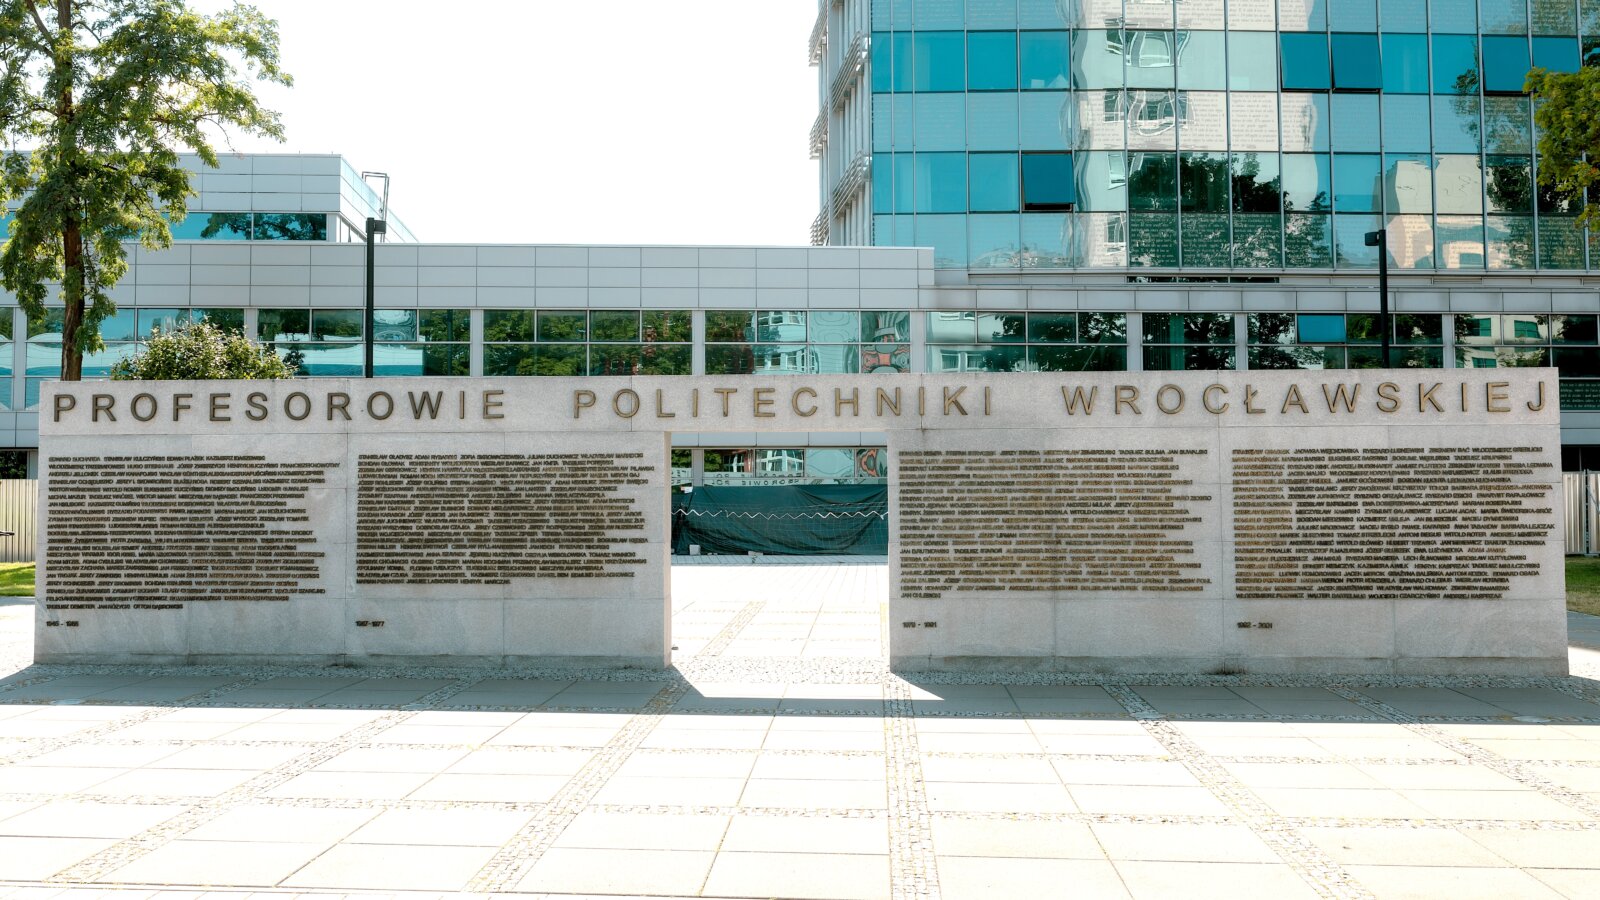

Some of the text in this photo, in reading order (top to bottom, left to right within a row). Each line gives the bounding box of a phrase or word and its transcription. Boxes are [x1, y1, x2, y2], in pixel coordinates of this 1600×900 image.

[54, 389, 505, 422] PROFESOROWIE
[573, 386, 991, 418] POLITECHNIKI
[1061, 382, 1545, 415] WROCŁAWSKIEJ
